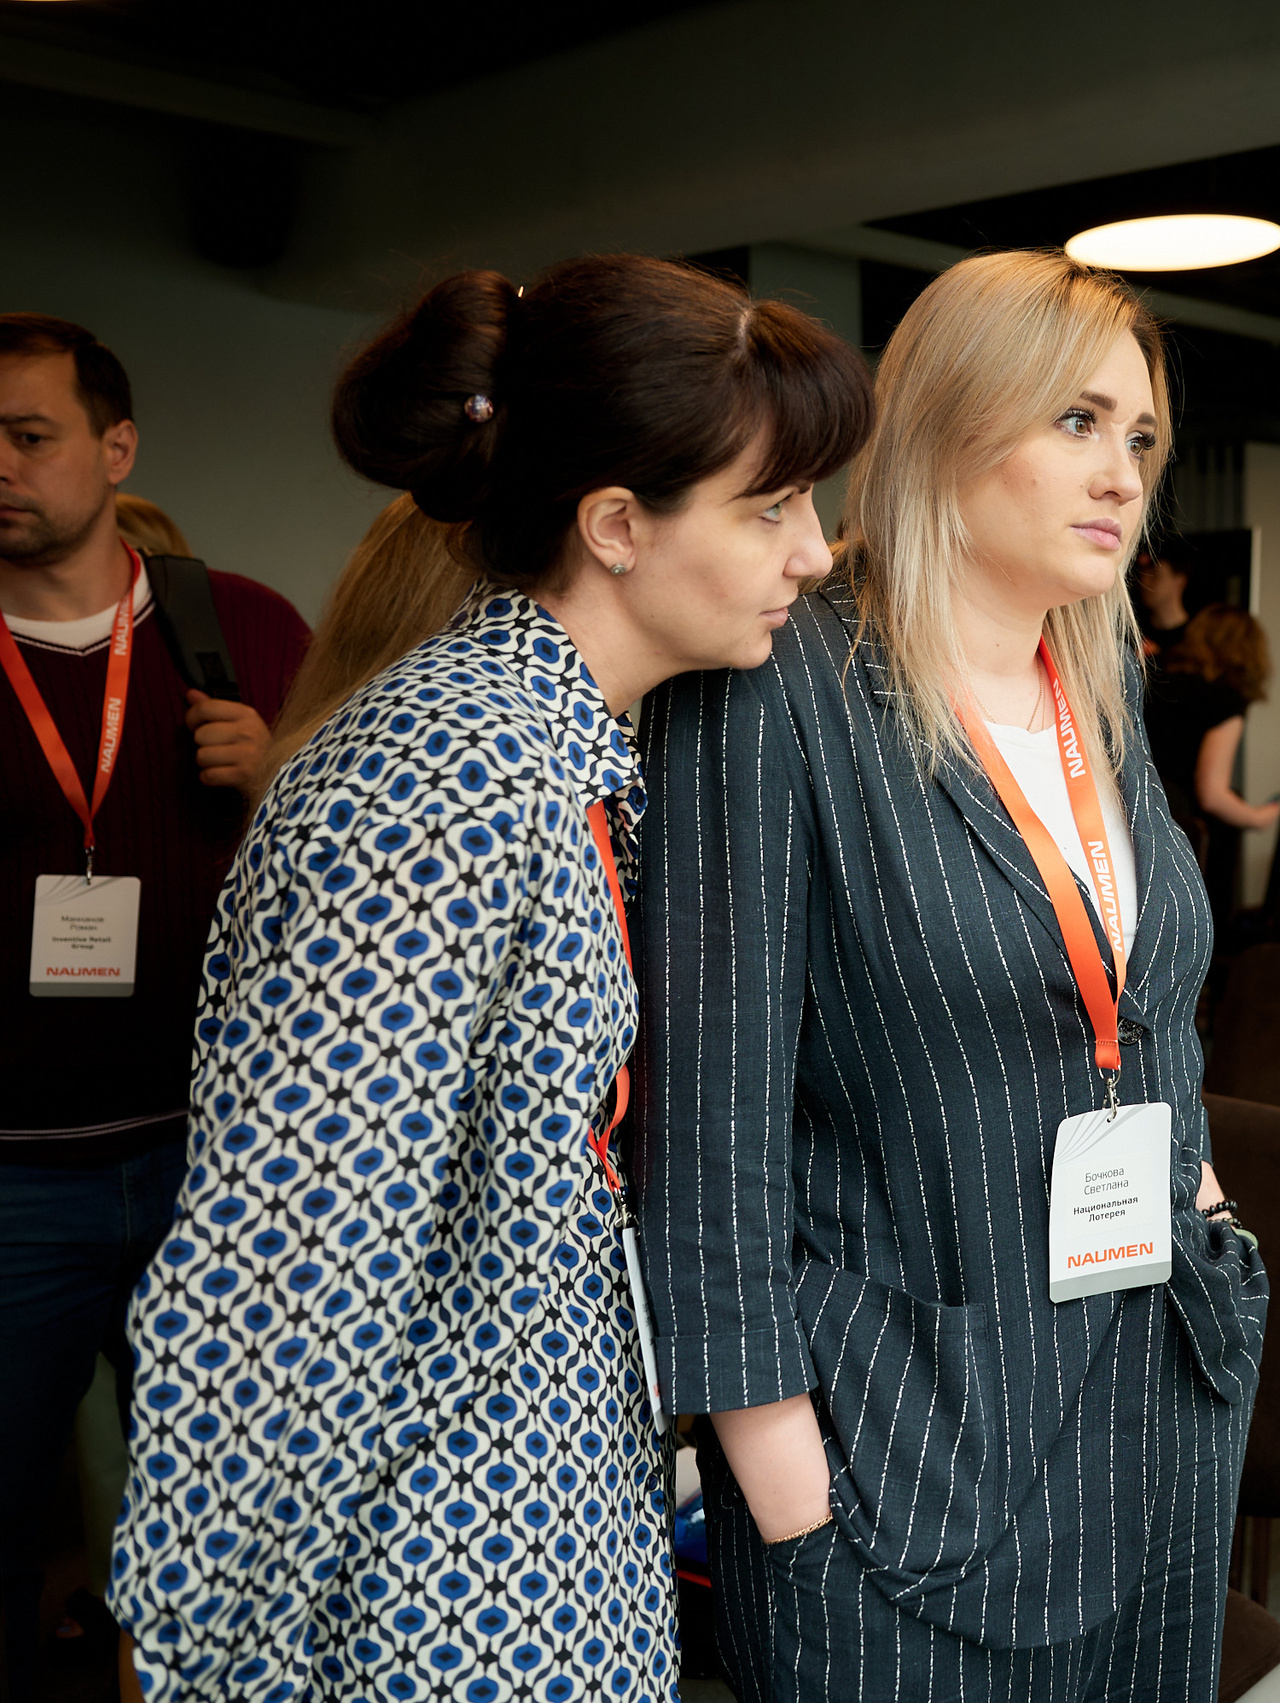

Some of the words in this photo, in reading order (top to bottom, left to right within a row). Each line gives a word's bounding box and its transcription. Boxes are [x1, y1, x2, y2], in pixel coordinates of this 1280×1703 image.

[114, 596, 130, 656] NAUME
[101, 697, 122, 773] NAUMEN
[1053, 678, 1086, 778] NAUMEN
[1087, 840, 1123, 952] NAUMEN
[46, 967, 120, 977] NAUMEN
[1085, 1167, 1125, 1183] Бочкова
[1083, 1179, 1129, 1196] Светлана
[1073, 1196, 1139, 1216] Национальная
[1088, 1209, 1126, 1222] Лотерея
[1067, 1242, 1154, 1269] NAUMEN
